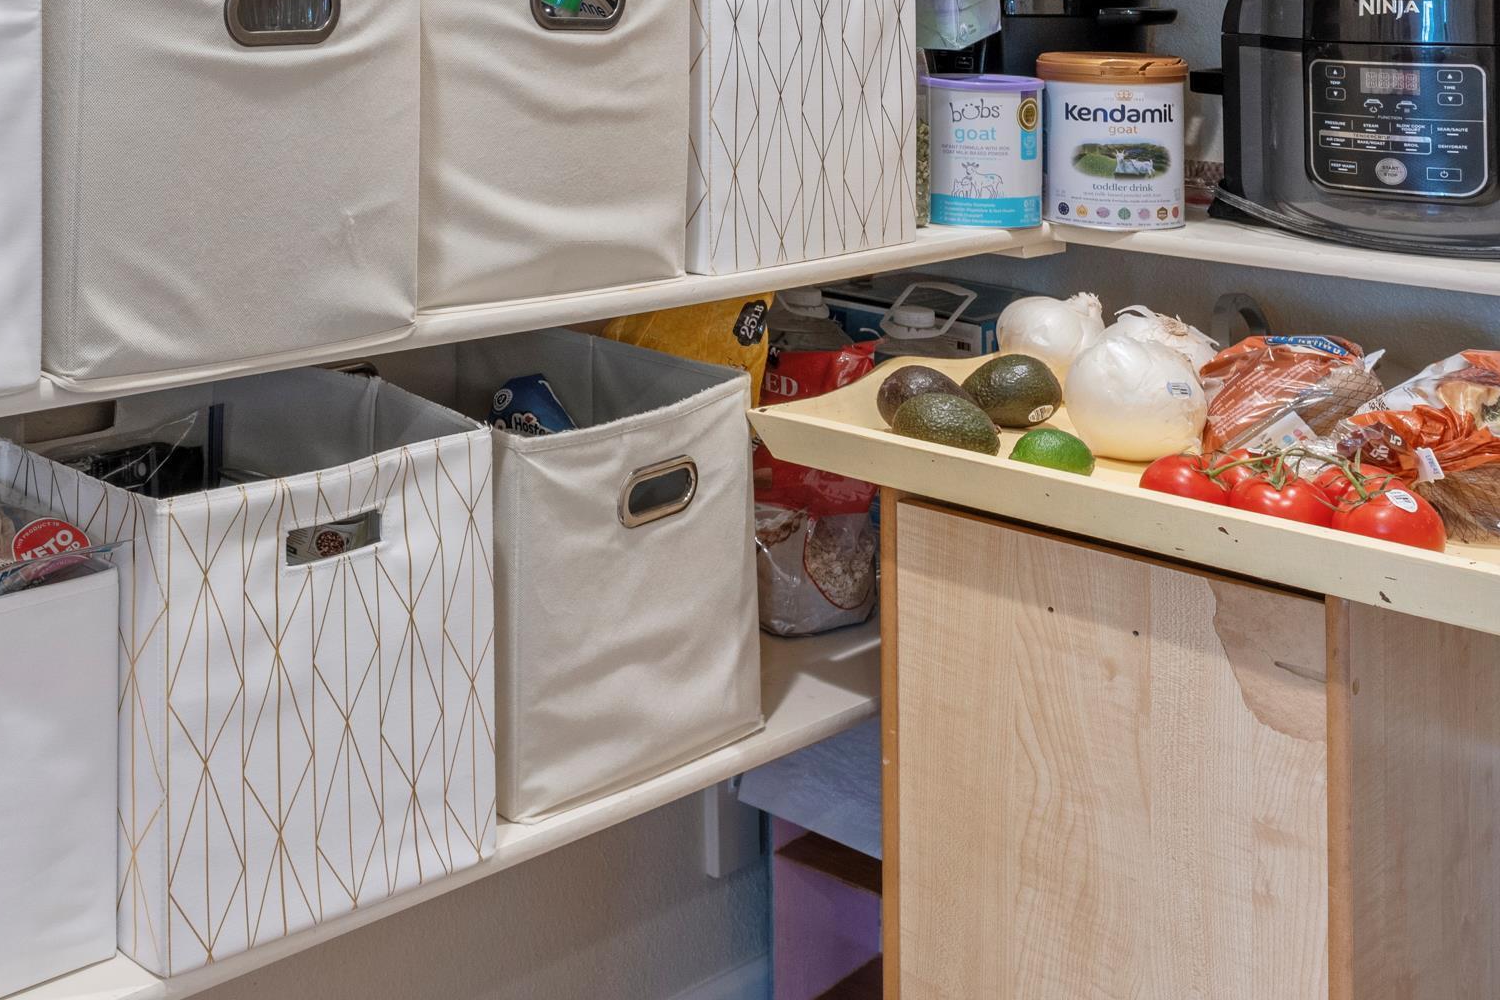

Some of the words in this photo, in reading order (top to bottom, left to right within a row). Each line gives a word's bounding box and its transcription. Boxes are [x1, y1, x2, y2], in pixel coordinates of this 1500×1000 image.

[954, 126, 997, 143] goat
[1108, 125, 1138, 136] goat
[1092, 183, 1127, 192] toddler
[1129, 184, 1154, 192] drink
[20, 529, 74, 561] KETO
